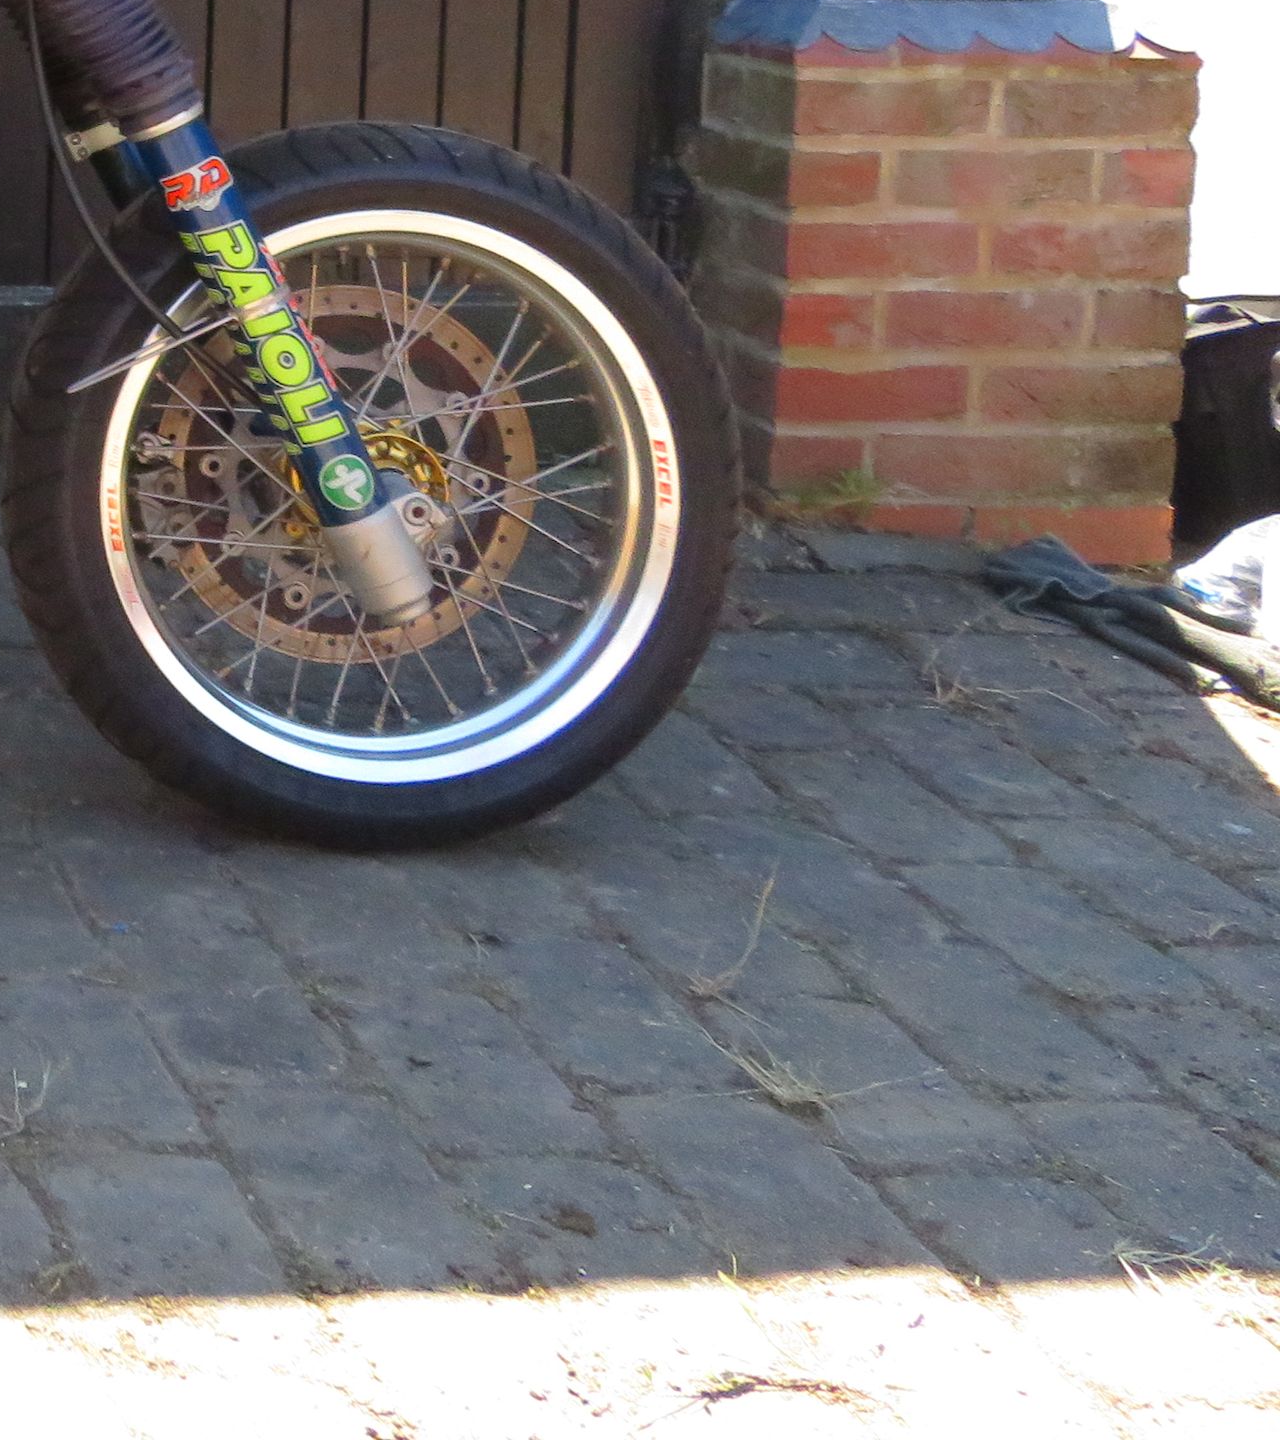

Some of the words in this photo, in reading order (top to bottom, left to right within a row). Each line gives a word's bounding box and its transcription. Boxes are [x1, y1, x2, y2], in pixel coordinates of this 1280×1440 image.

[195, 219, 350, 447] PAIOLI
[651, 439, 673, 509] EXCEL
[107, 482, 125, 553] EXCEL
